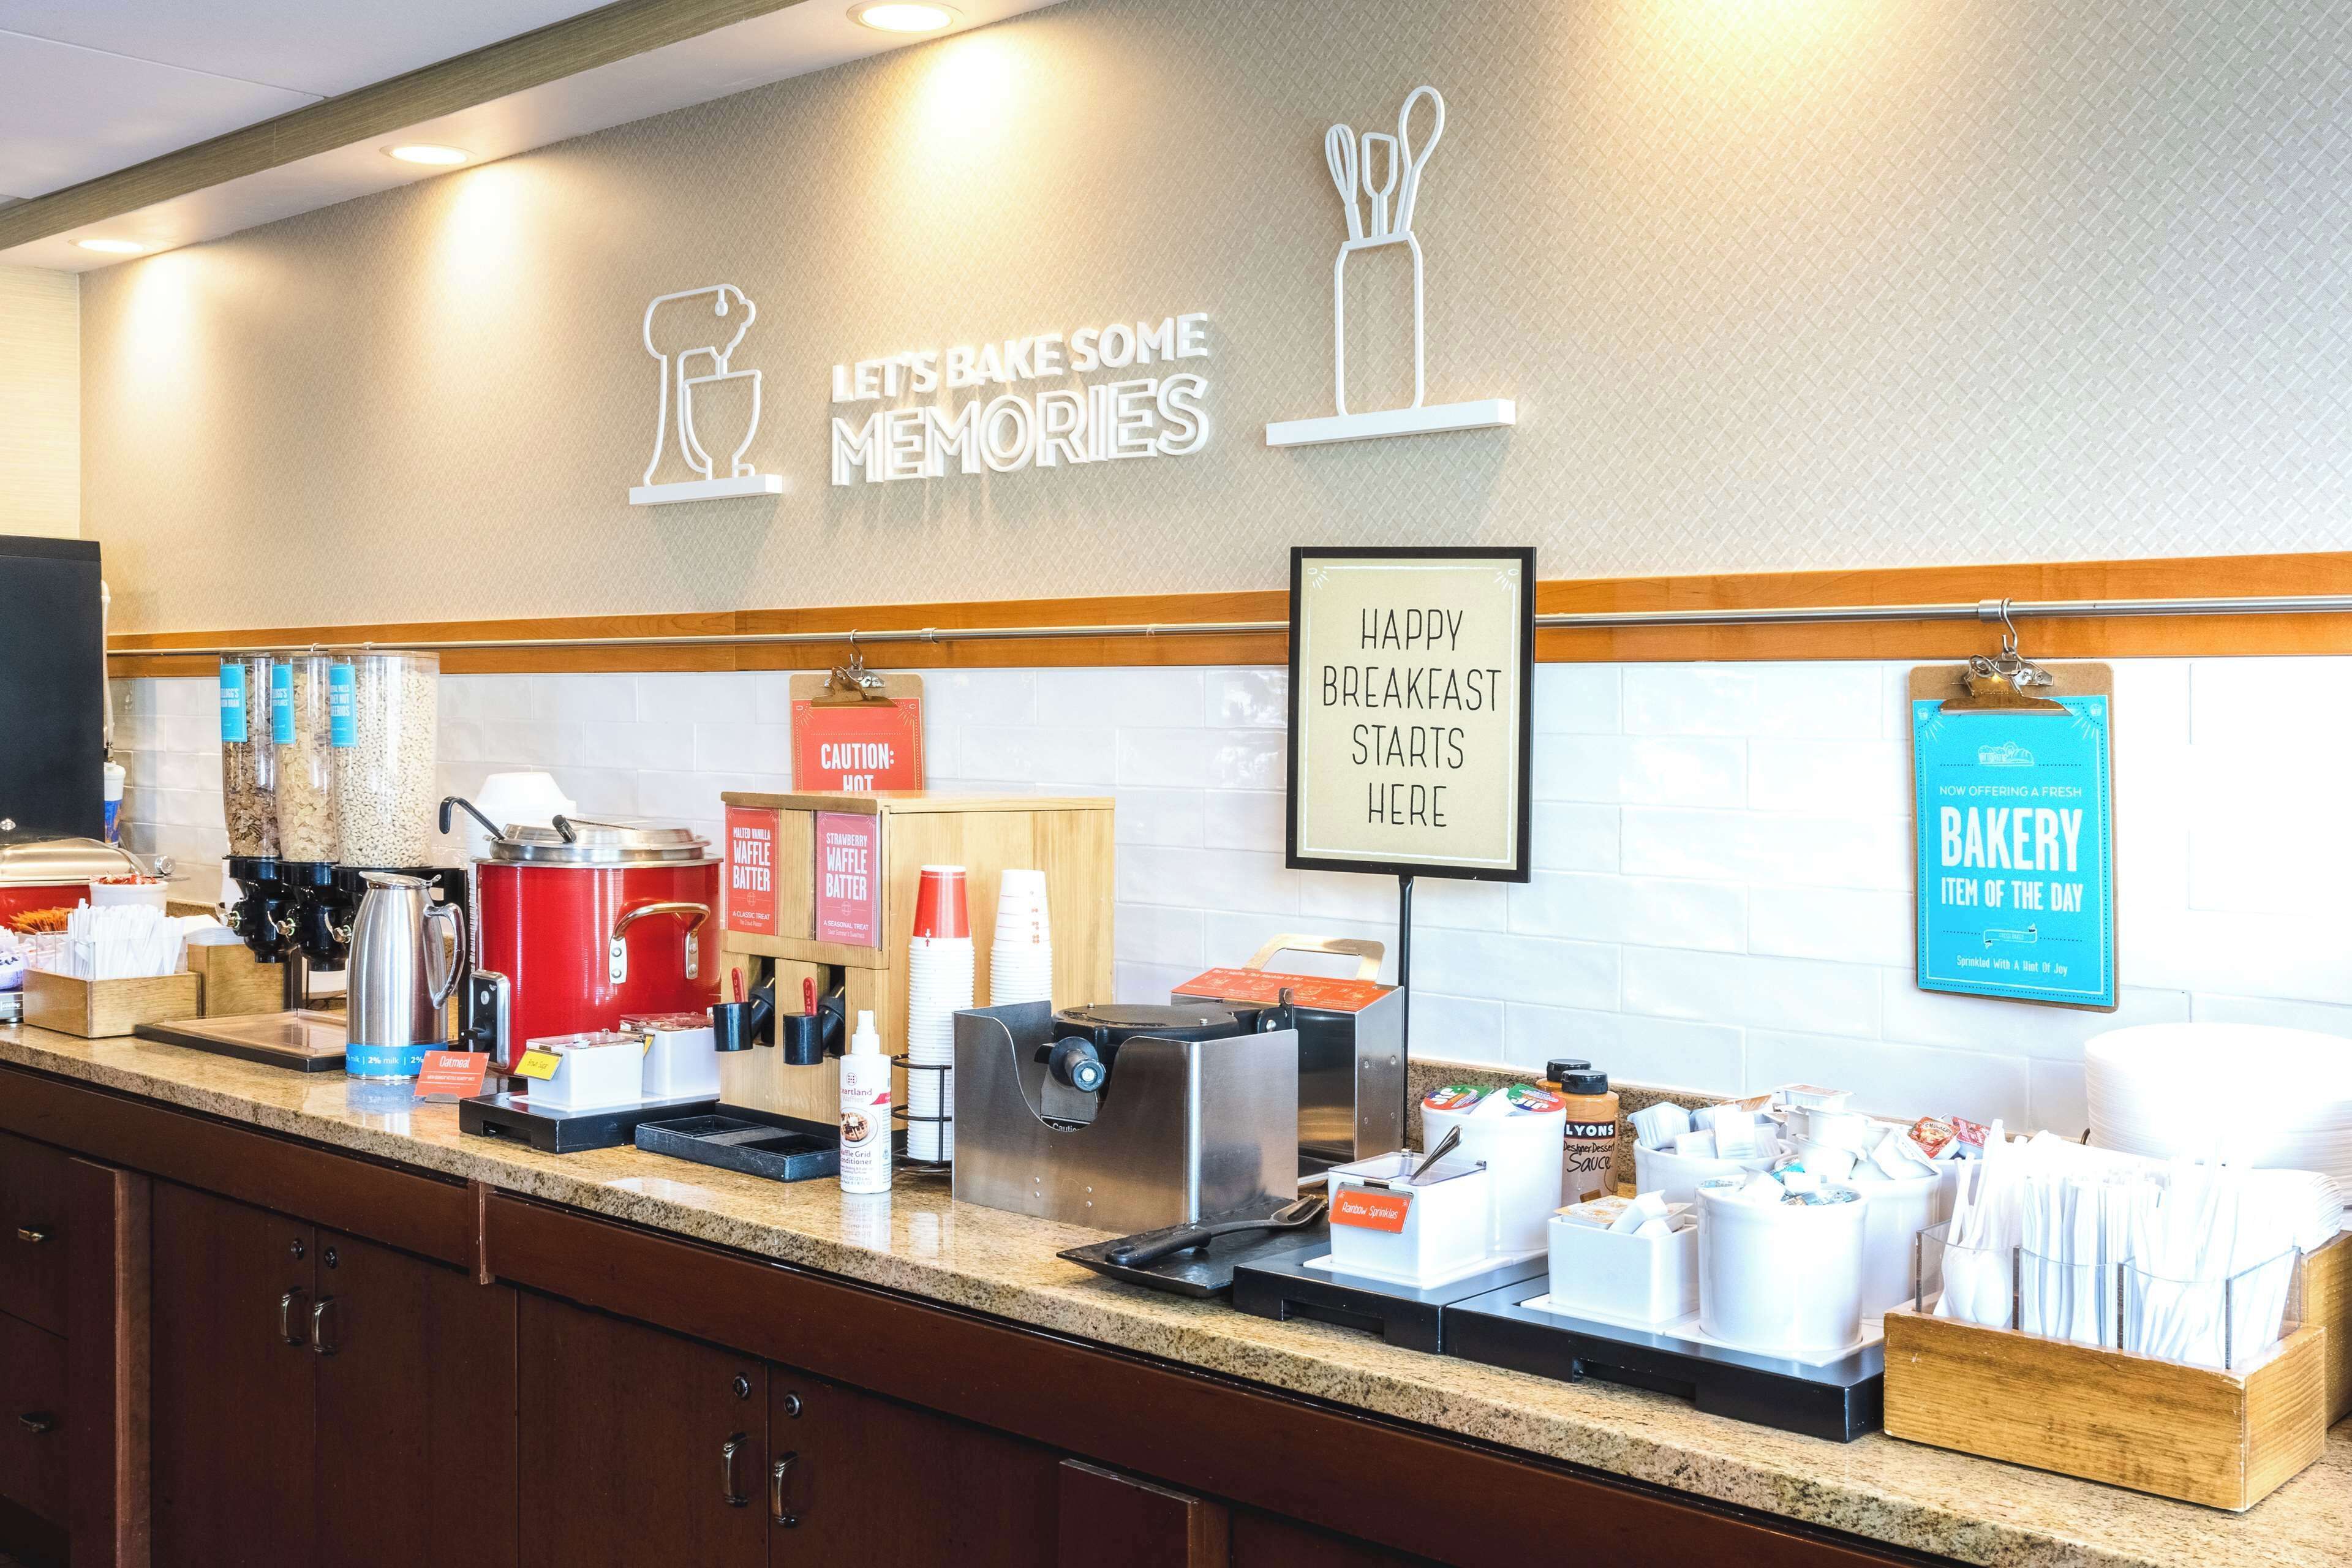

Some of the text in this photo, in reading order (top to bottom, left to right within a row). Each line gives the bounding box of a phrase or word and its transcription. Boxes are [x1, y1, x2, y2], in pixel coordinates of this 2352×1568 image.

[832, 312, 1208, 404] LET'S BAKE SOME
[831, 373, 1210, 486] MEMORIES
[1362, 608, 1463, 651] HAPPY
[1324, 665, 1502, 711] BREAKFAST
[821, 742, 895, 769] CAUTION:
[1352, 724, 1464, 769] STARTS
[843, 774, 874, 791] HOT
[1939, 785, 2082, 797] NOW OFFERING A FRESH
[1369, 782, 1447, 827] HERE
[733, 827, 771, 841] MALTED VANILLA
[826, 832, 868, 847] STRAWBERRY
[1940, 805, 2083, 872] BAKERY
[733, 840, 771, 867] WAFFLE
[826, 846, 868, 874] WAFFLE
[733, 865, 771, 892] BATTER
[826, 873, 867, 901] BATTER
[1941, 876, 2084, 912] ITEM OF THE DAY
[827, 920, 853, 929] SEASONAL
[1956, 954, 2068, 977] Sprinkled With A Hint Of Joy
[368, 1056, 382, 1065] 2%
[383, 1056, 399, 1065] milk
[439, 1055, 470, 1069] Oatmeal
[1052, 1123, 1079, 1132] Cautio
[1566, 1124, 1614, 1136] LYONS
[1563, 1140, 1593, 1156] Designer
[1567, 1152, 1611, 1172] Sauce
[1341, 1202, 1398, 1219] Rainbow Sprinkles
